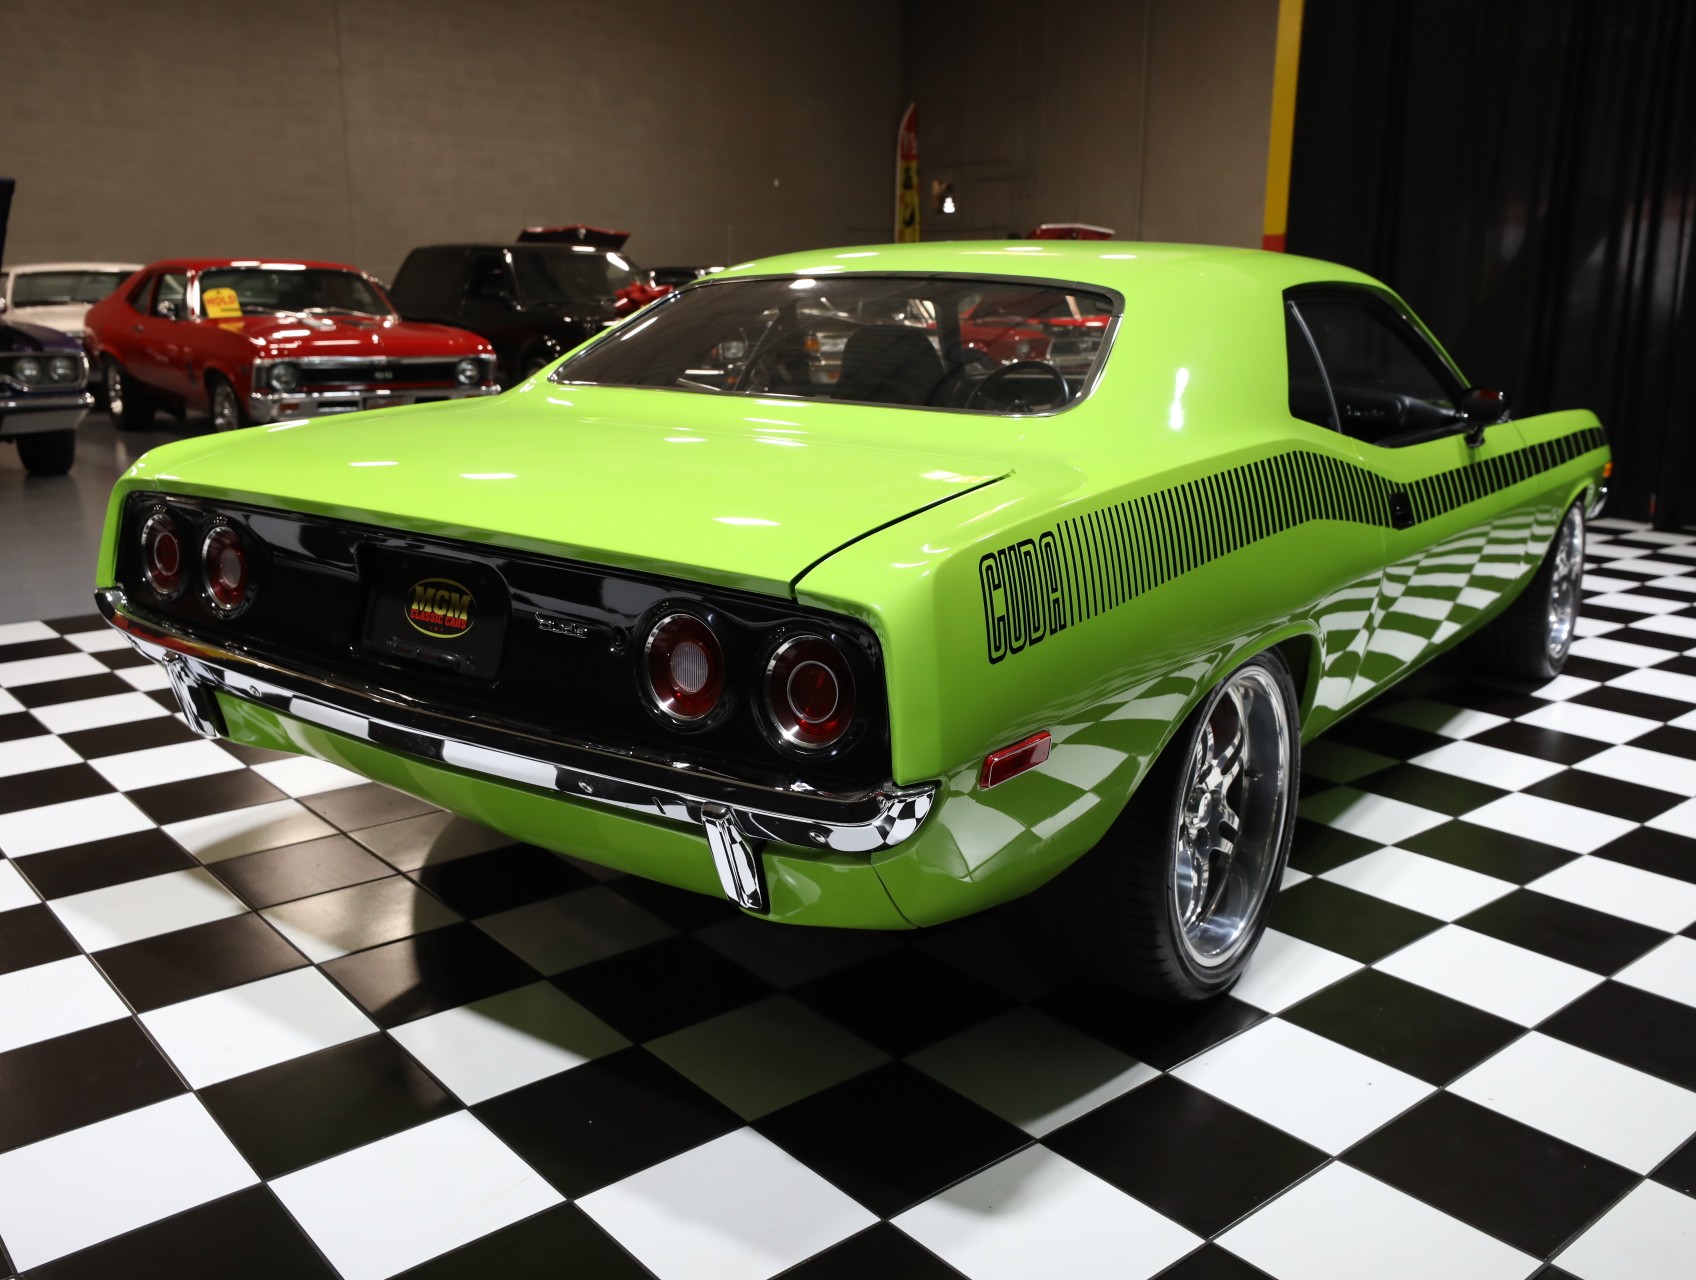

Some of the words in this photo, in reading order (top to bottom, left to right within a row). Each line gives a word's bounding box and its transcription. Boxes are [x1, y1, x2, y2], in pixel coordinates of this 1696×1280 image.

[411, 585, 471, 620] MGM
[978, 530, 1067, 665] CUDA
[410, 608, 444, 625] CLASSIC
[444, 615, 467, 630] CARS
